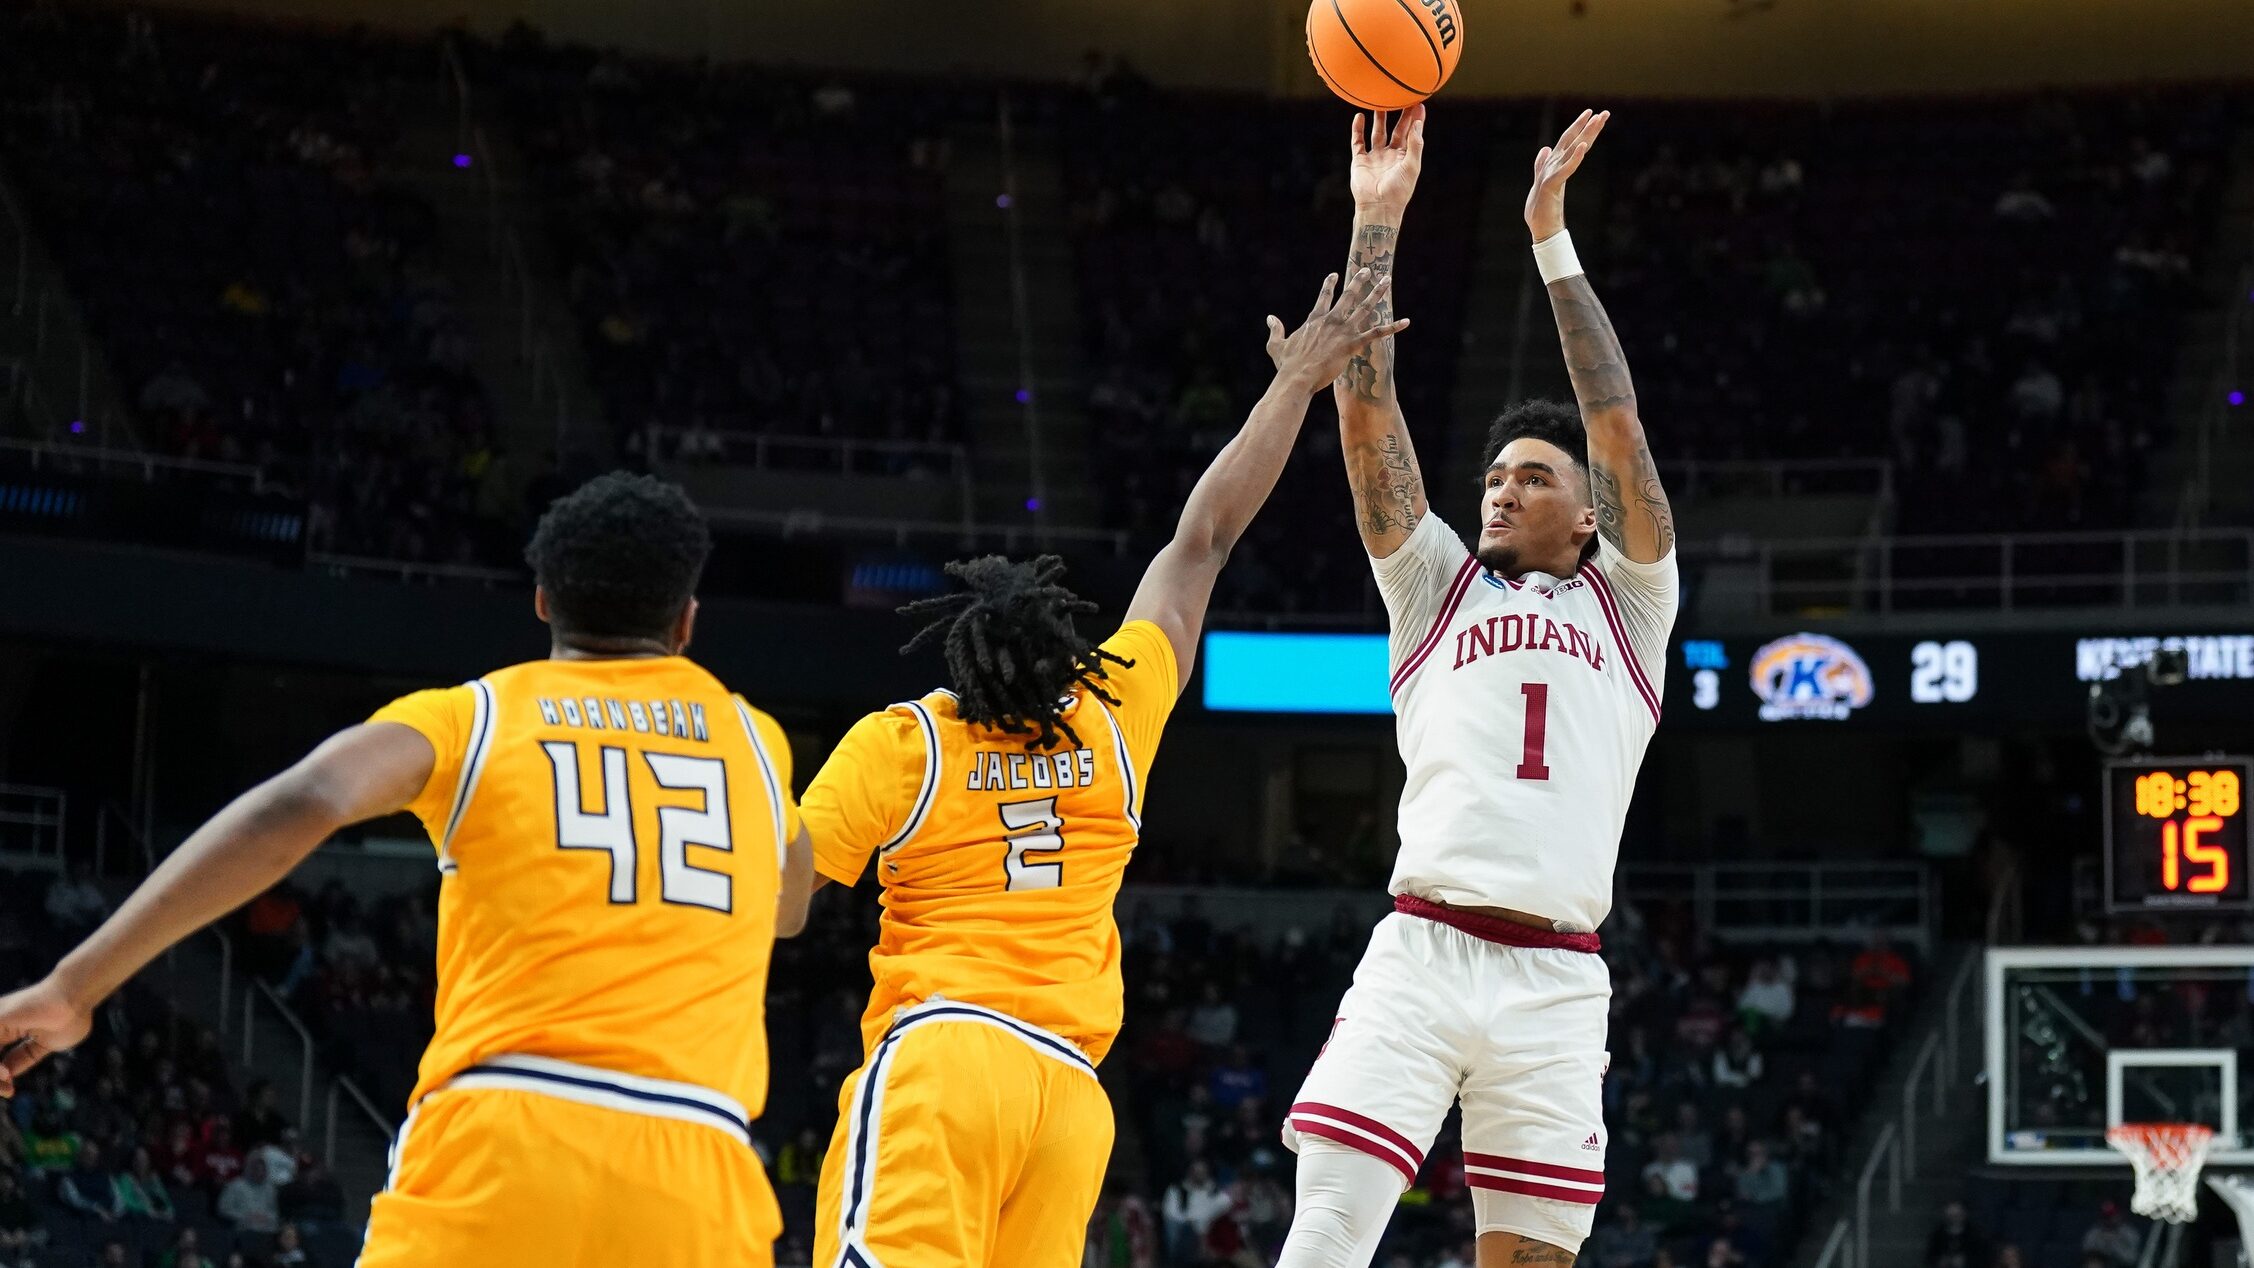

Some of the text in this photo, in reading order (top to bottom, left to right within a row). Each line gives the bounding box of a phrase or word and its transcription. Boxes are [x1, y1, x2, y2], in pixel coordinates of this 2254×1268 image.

[1421, 0, 1456, 50] Wi
[1693, 669, 1720, 711] 3
[1911, 641, 1978, 703] 29
[537, 696, 709, 743] HORNBEAK
[1516, 682, 1550, 780] 1
[967, 748, 1095, 791] JACOBS
[2135, 770, 2240, 819] 18:38
[538, 740, 733, 915] 42
[998, 795, 1065, 893] 2
[2162, 815, 2230, 893] 15
